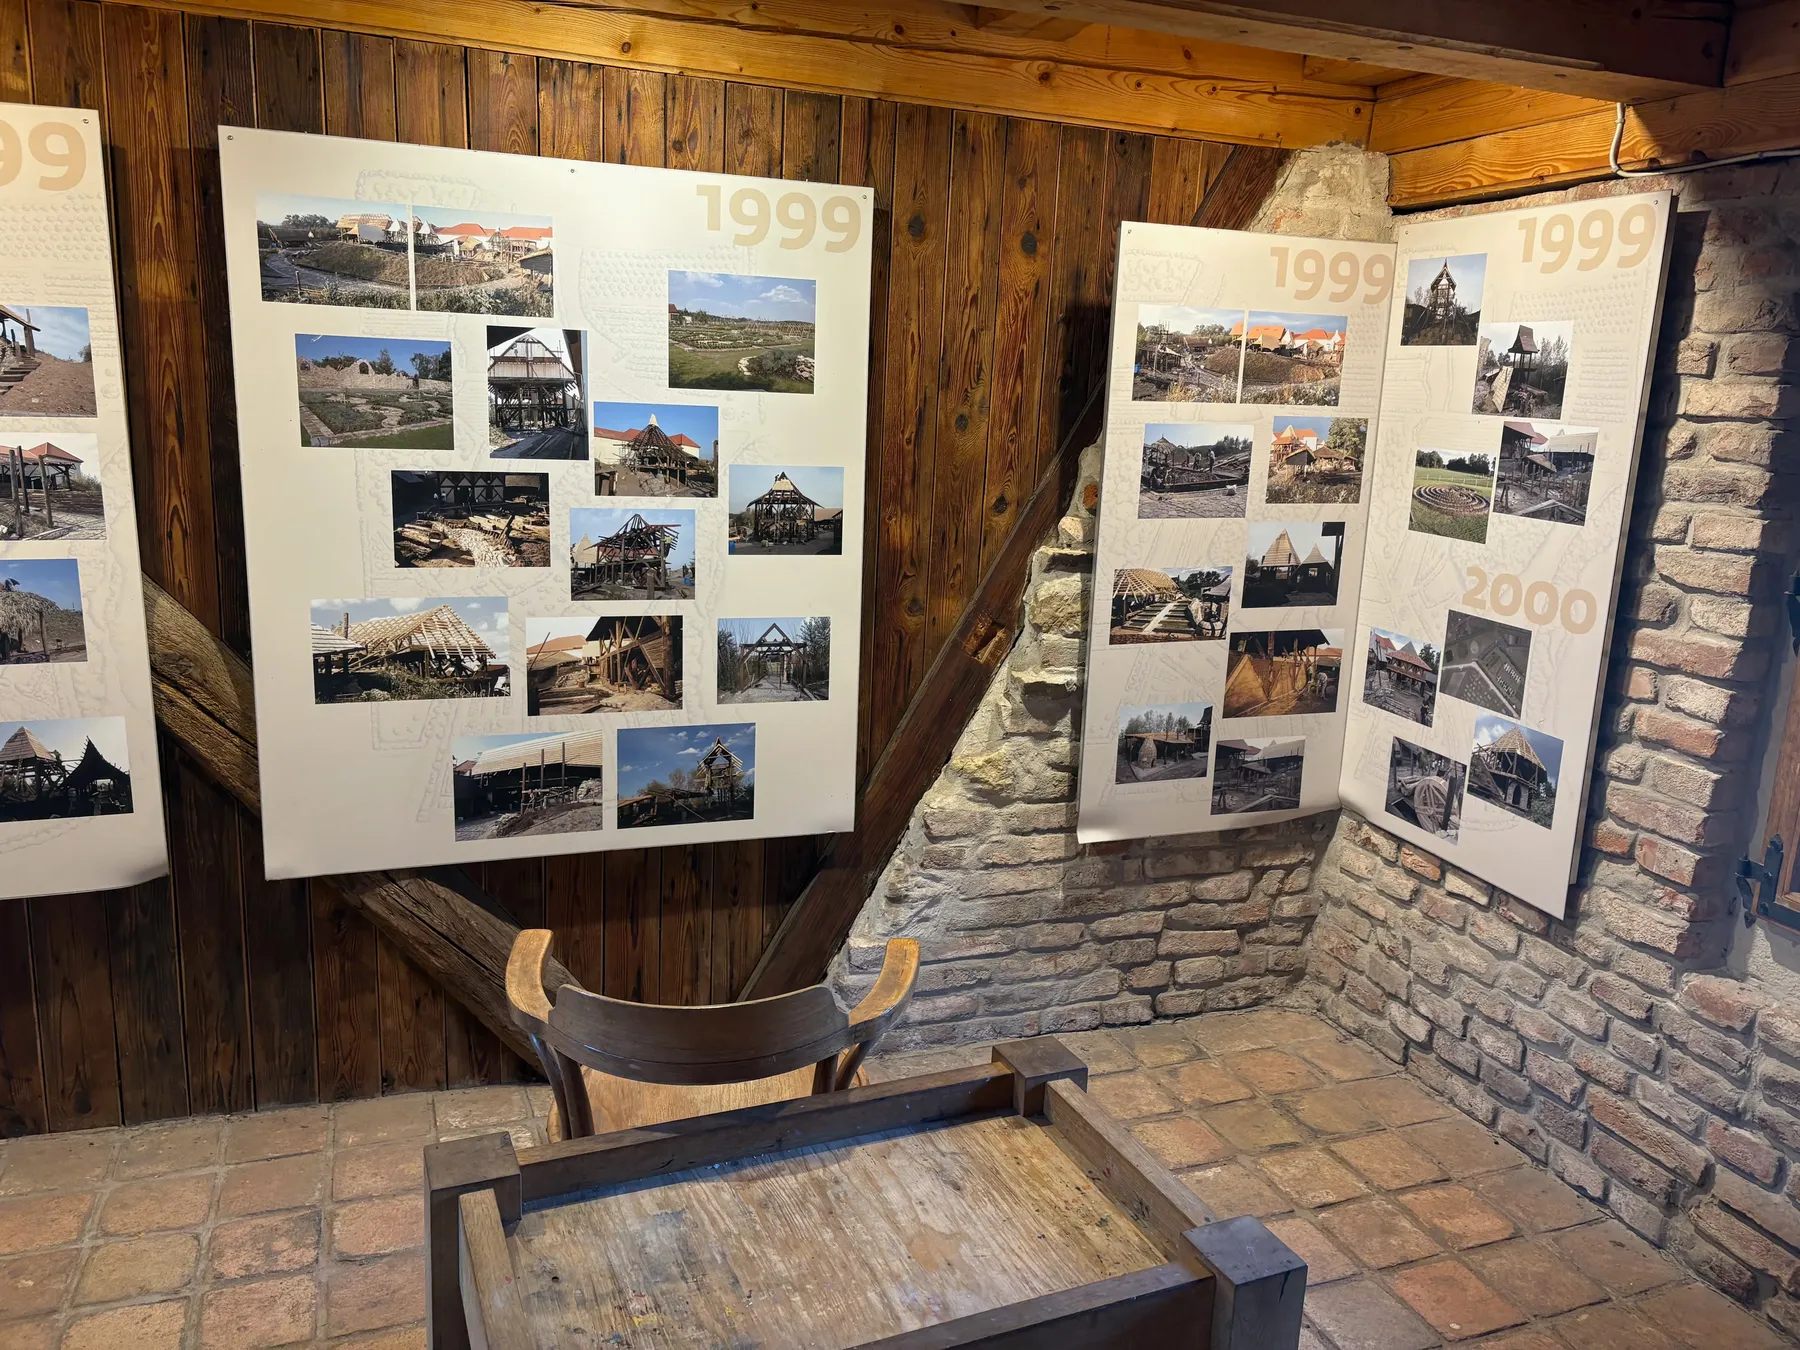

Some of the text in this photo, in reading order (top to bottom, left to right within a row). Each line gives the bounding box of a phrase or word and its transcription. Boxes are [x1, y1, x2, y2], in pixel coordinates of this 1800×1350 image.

[697, 184, 861, 253] 1999
[1518, 204, 1656, 274] 1999
[1270, 246, 1393, 305] 1999
[1462, 566, 1598, 634] 2000
